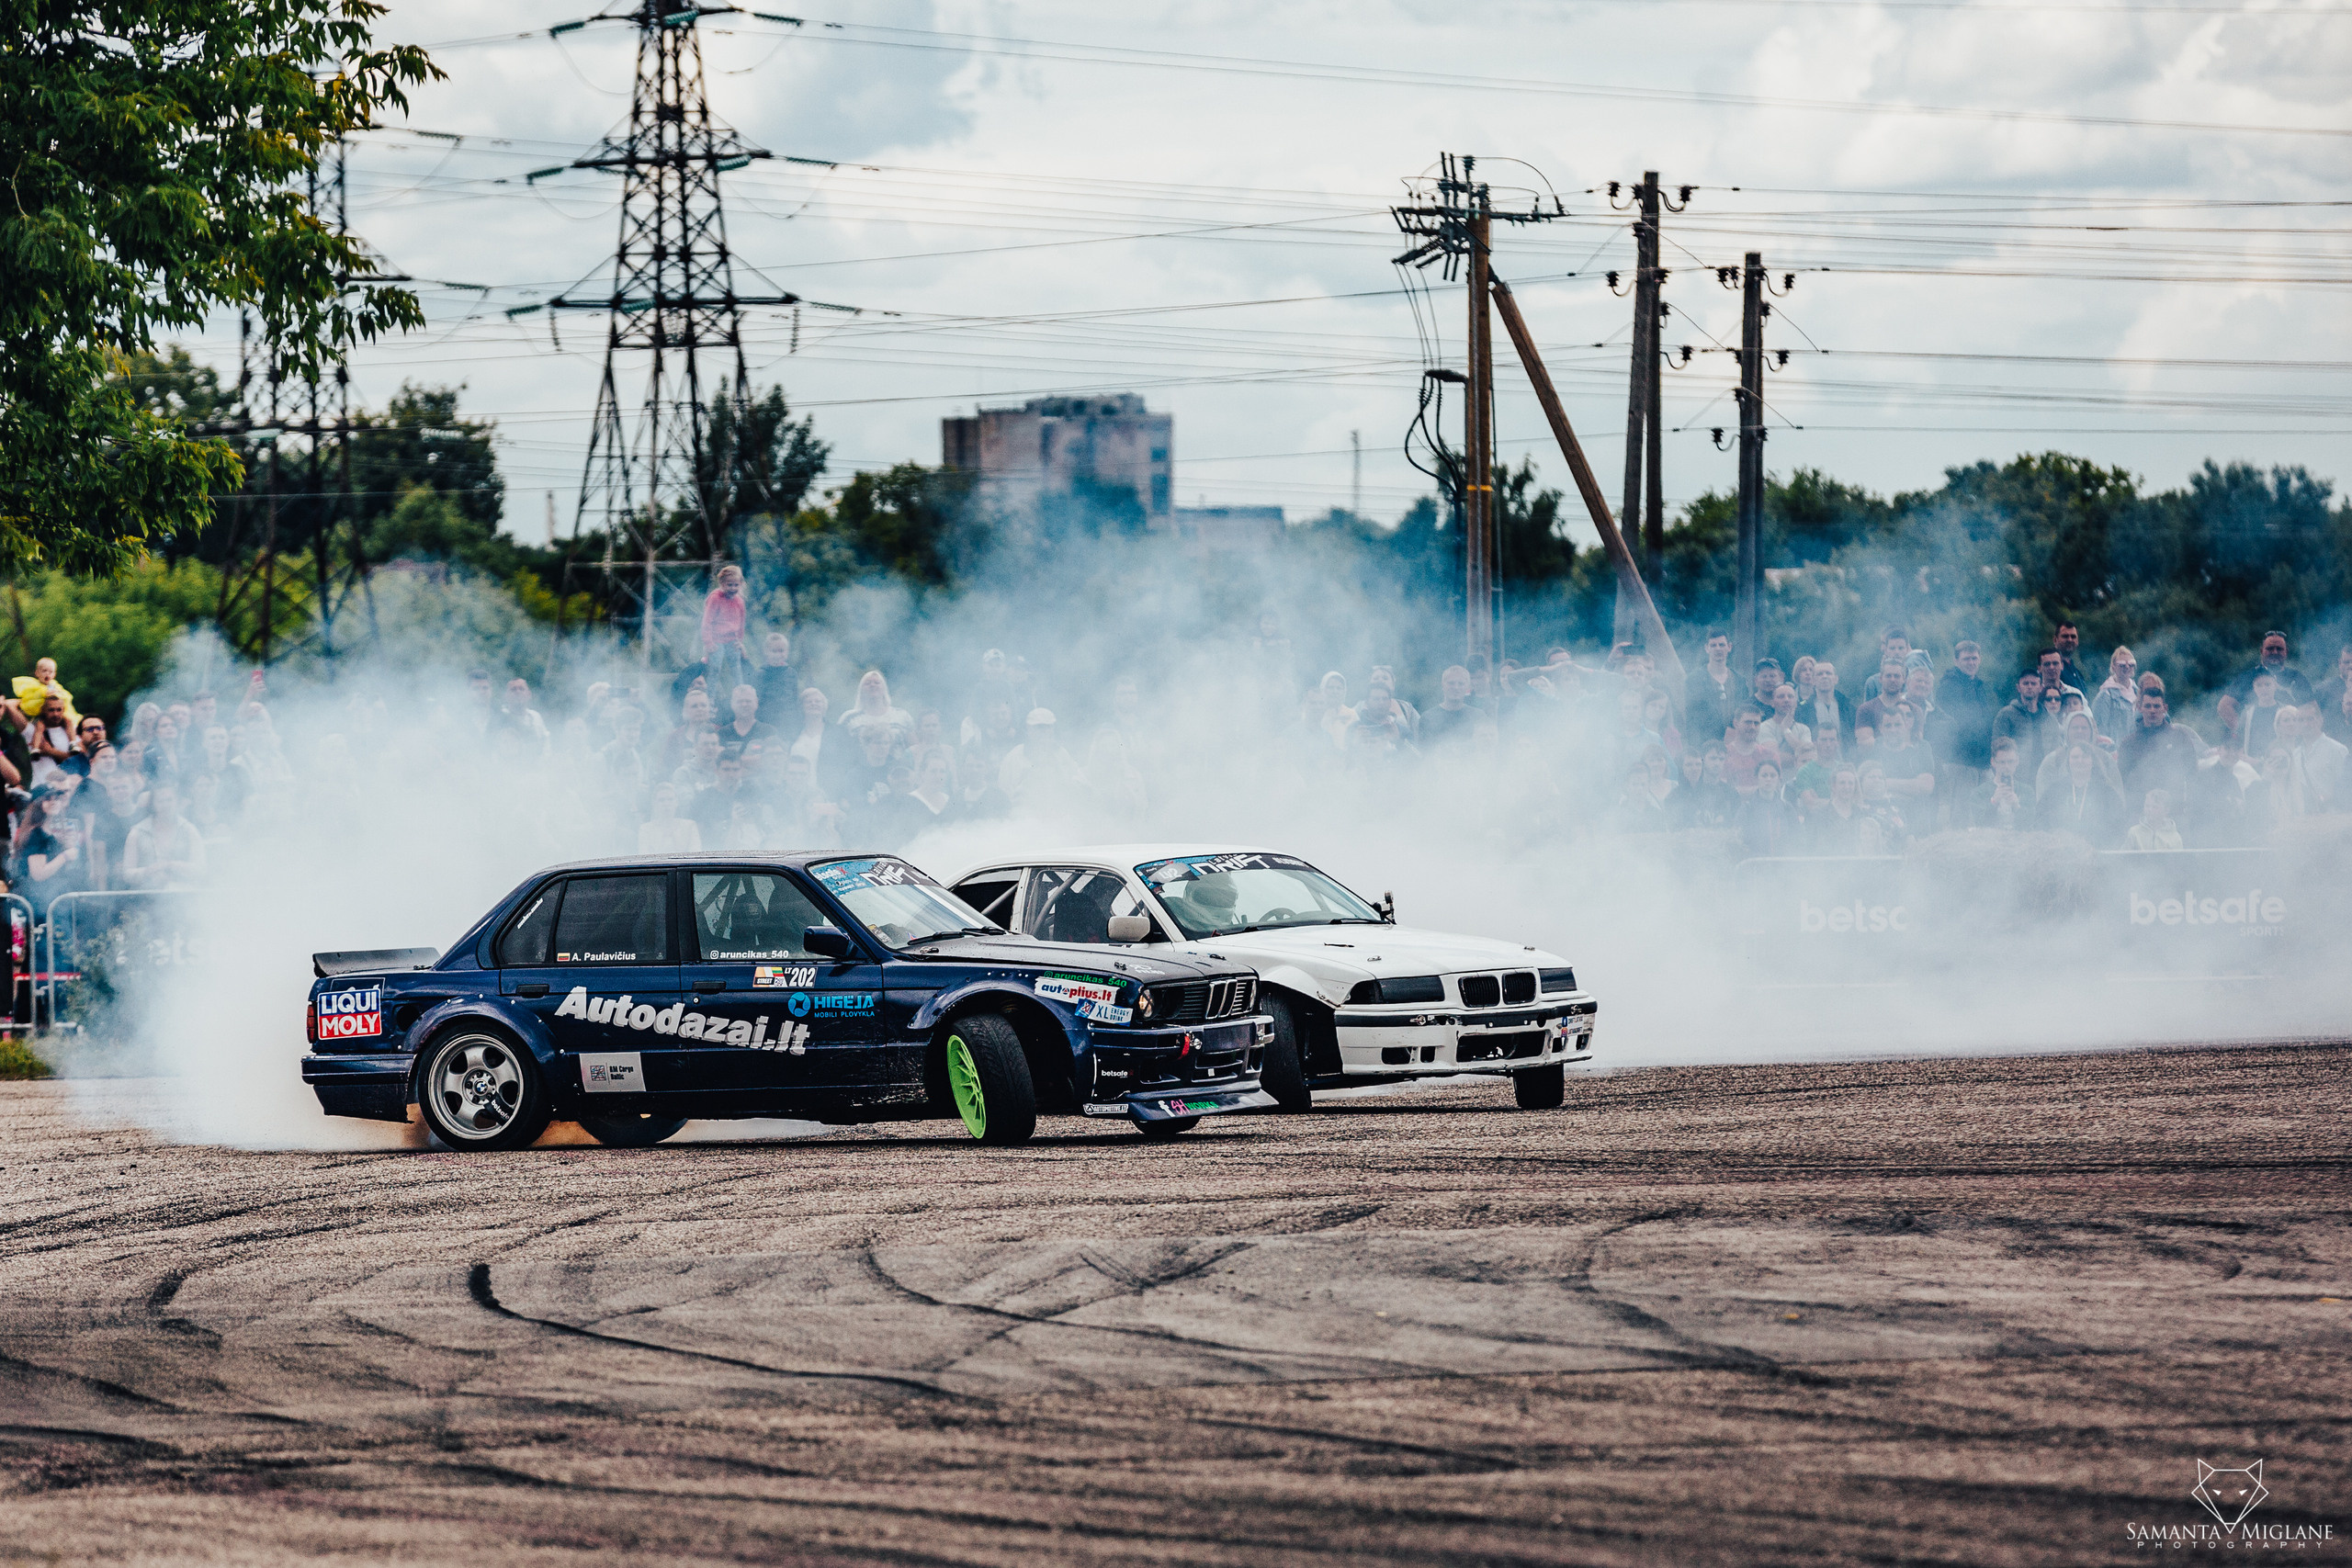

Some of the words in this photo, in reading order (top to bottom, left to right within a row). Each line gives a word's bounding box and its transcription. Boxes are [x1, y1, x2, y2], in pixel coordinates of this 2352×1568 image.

[1191, 853, 1270, 874] DRIFT
[1800, 898, 1909, 932] betsa
[2130, 888, 2287, 925] betsafe
[571, 953, 582, 961] A.
[583, 952, 636, 961] Paulavičius
[719, 950, 789, 961] aruncikas_540
[788, 967, 816, 987] 202
[321, 991, 378, 1015] LIQUI
[1096, 1005, 1109, 1019] XL
[1111, 1008, 1130, 1016] ENERGY
[322, 1013, 379, 1037] MOLY
[554, 986, 811, 1055] Autodazai.lt
